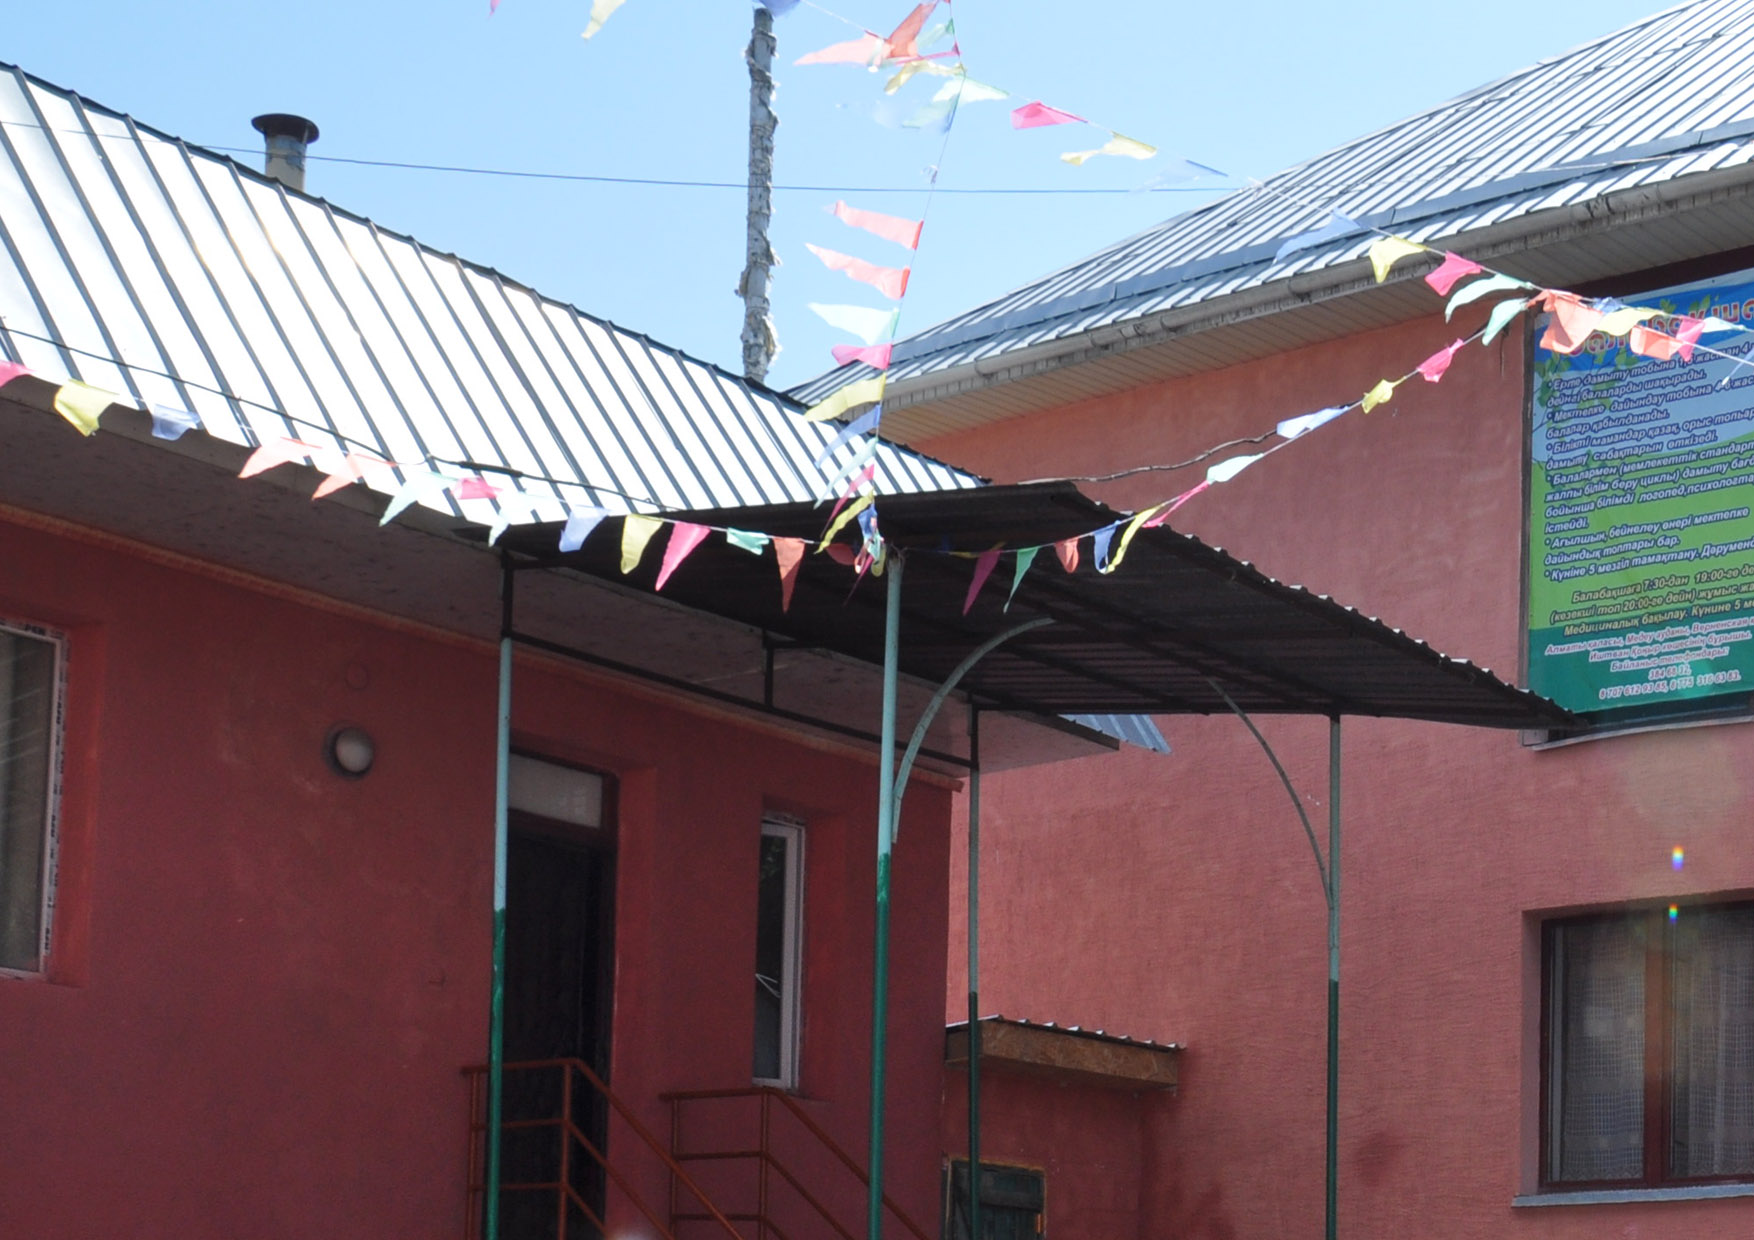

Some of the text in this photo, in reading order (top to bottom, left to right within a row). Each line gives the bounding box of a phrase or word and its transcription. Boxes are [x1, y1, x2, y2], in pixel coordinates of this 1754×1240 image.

[1582, 369, 1706, 401] балаларды шақырады.
[1584, 369, 1628, 385] дамыту
[1632, 360, 1674, 376] тобына
[1554, 404, 1605, 420] Мектепке
[1610, 394, 1664, 412] дайындау
[1666, 385, 1712, 402] тобына
[1547, 409, 1670, 439] балалар қабылданады.
[1554, 436, 1590, 453] Білікті
[1592, 428, 1646, 447] мамандар
[1684, 417, 1712, 432] орыс
[1546, 454, 1588, 470] дамыту
[1594, 442, 1662, 461] сабақтарын
[1554, 466, 1617, 485] Балалармен
[1620, 450, 1698, 476] (мемлекеттік
[1546, 488, 1582, 502] жалпы
[1584, 480, 1610, 495] білім
[1612, 478, 1638, 492] беру
[1640, 468, 1680, 488] циклы)
[1682, 463, 1728, 479] дамыту
[1545, 502, 1595, 517] бойынша
[1597, 491, 1634, 509] білімді
[1545, 516, 1588, 534] істейді.
[1610, 523, 1660, 539] бейнелеу
[1694, 508, 1748, 525] мектепке
[1544, 535, 1680, 565] дайындық топтары бар.
[1588, 562, 1596, 575] 5
[1598, 557, 1630, 573] мезгіл
[1632, 551, 1698, 567] тамақтану.
[1564, 618, 1638, 636] Медициналық
[1642, 611, 1688, 626] бақылау.
[1734, 598, 1741, 611] 5
[1598, 603, 1620, 615] топ
[1544, 642, 1586, 657] Алматы
[1625, 630, 1654, 645] Медеу
[1692, 617, 1749, 634] Верненская
[1588, 648, 1630, 661] Иштван
[1610, 656, 1658, 671] Байланыс
[1606, 684, 1624, 698] 707
[1623, 683, 1642, 696] 612
[1640, 681, 1654, 695] 93
